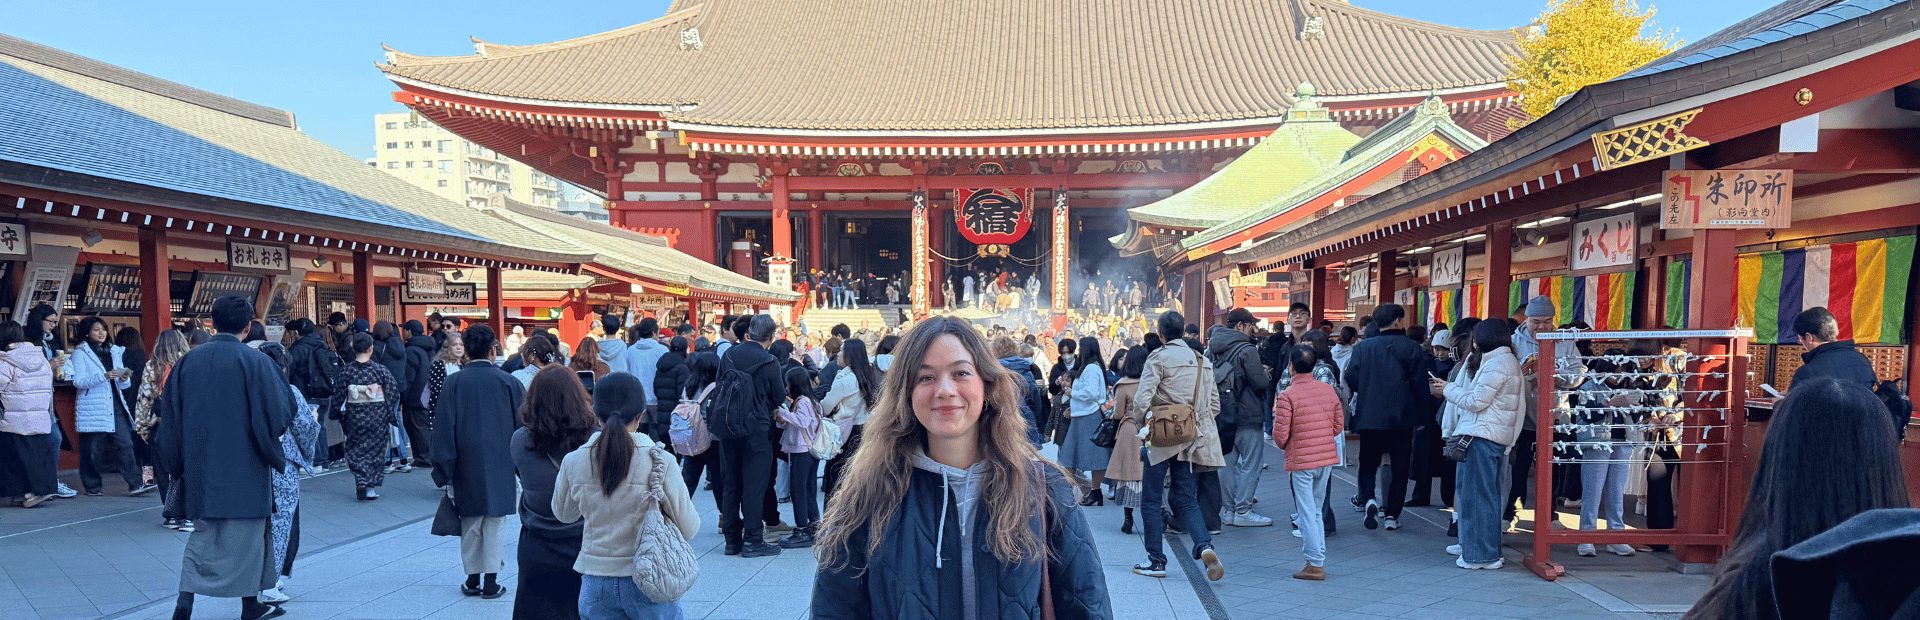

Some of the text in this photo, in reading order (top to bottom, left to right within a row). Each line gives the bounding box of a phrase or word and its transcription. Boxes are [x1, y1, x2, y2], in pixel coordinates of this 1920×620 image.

[1706, 172, 1787, 207] 朱印所
[1669, 187, 1680, 225] この先左
[0, 225, 19, 252] 守
[1579, 220, 1632, 262] みくじ
[234, 245, 283, 268] お札お守
[1434, 252, 1462, 281] みくじ
